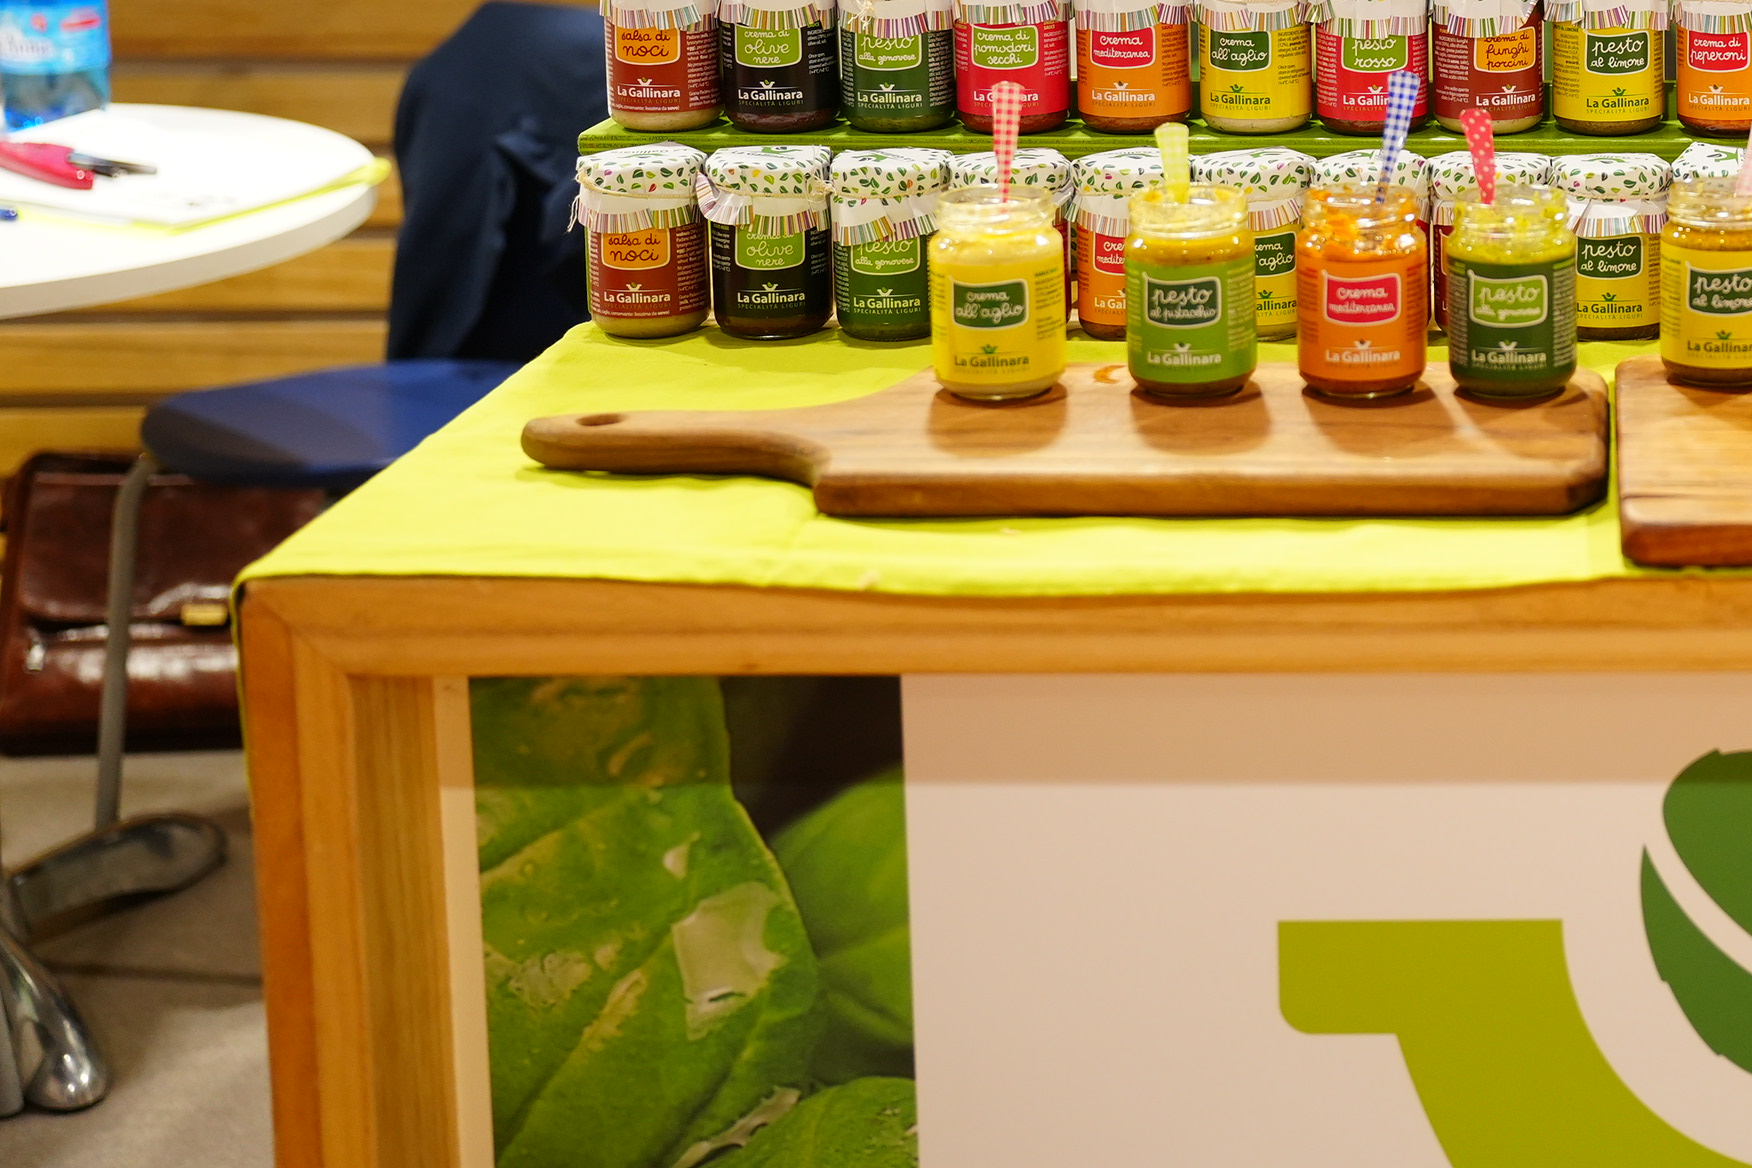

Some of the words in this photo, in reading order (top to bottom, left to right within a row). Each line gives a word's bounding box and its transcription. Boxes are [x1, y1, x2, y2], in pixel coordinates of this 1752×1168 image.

[622, 31, 645, 43] salsa
[651, 30, 668, 43] di
[1099, 36, 1143, 47] crema
[623, 42, 669, 57] noci
[1592, 38, 1644, 56] pesto
[1093, 48, 1150, 60] mediterranea
[1591, 58, 1603, 68] al
[1607, 55, 1645, 68] limone
[617, 87, 630, 97] La
[632, 87, 680, 98] Gallinara
[1092, 90, 1103, 101] La
[1106, 90, 1155, 101] Gallinara
[1587, 98, 1598, 108] La
[1600, 97, 1649, 109] Gallinara
[608, 236, 635, 247] salsa
[640, 234, 658, 247] di
[612, 246, 657, 262] noci
[1582, 244, 1636, 260] pesto
[1581, 261, 1593, 271] al
[1598, 260, 1637, 273] limone
[604, 291, 616, 301] La
[619, 291, 671, 304] Gallinara
[1151, 288, 1212, 306] pesto
[1479, 287, 1540, 306] pesto
[1577, 303, 1588, 313] La
[1591, 303, 1642, 314] Gallinara
[1688, 341, 1701, 351] La
[954, 354, 967, 366] La
[970, 354, 1029, 368] Gallinara
[1148, 353, 1160, 364] La
[1162, 352, 1221, 364] Gallinara
[1472, 351, 1486, 361] La
[1488, 350, 1546, 363] Gallinara
